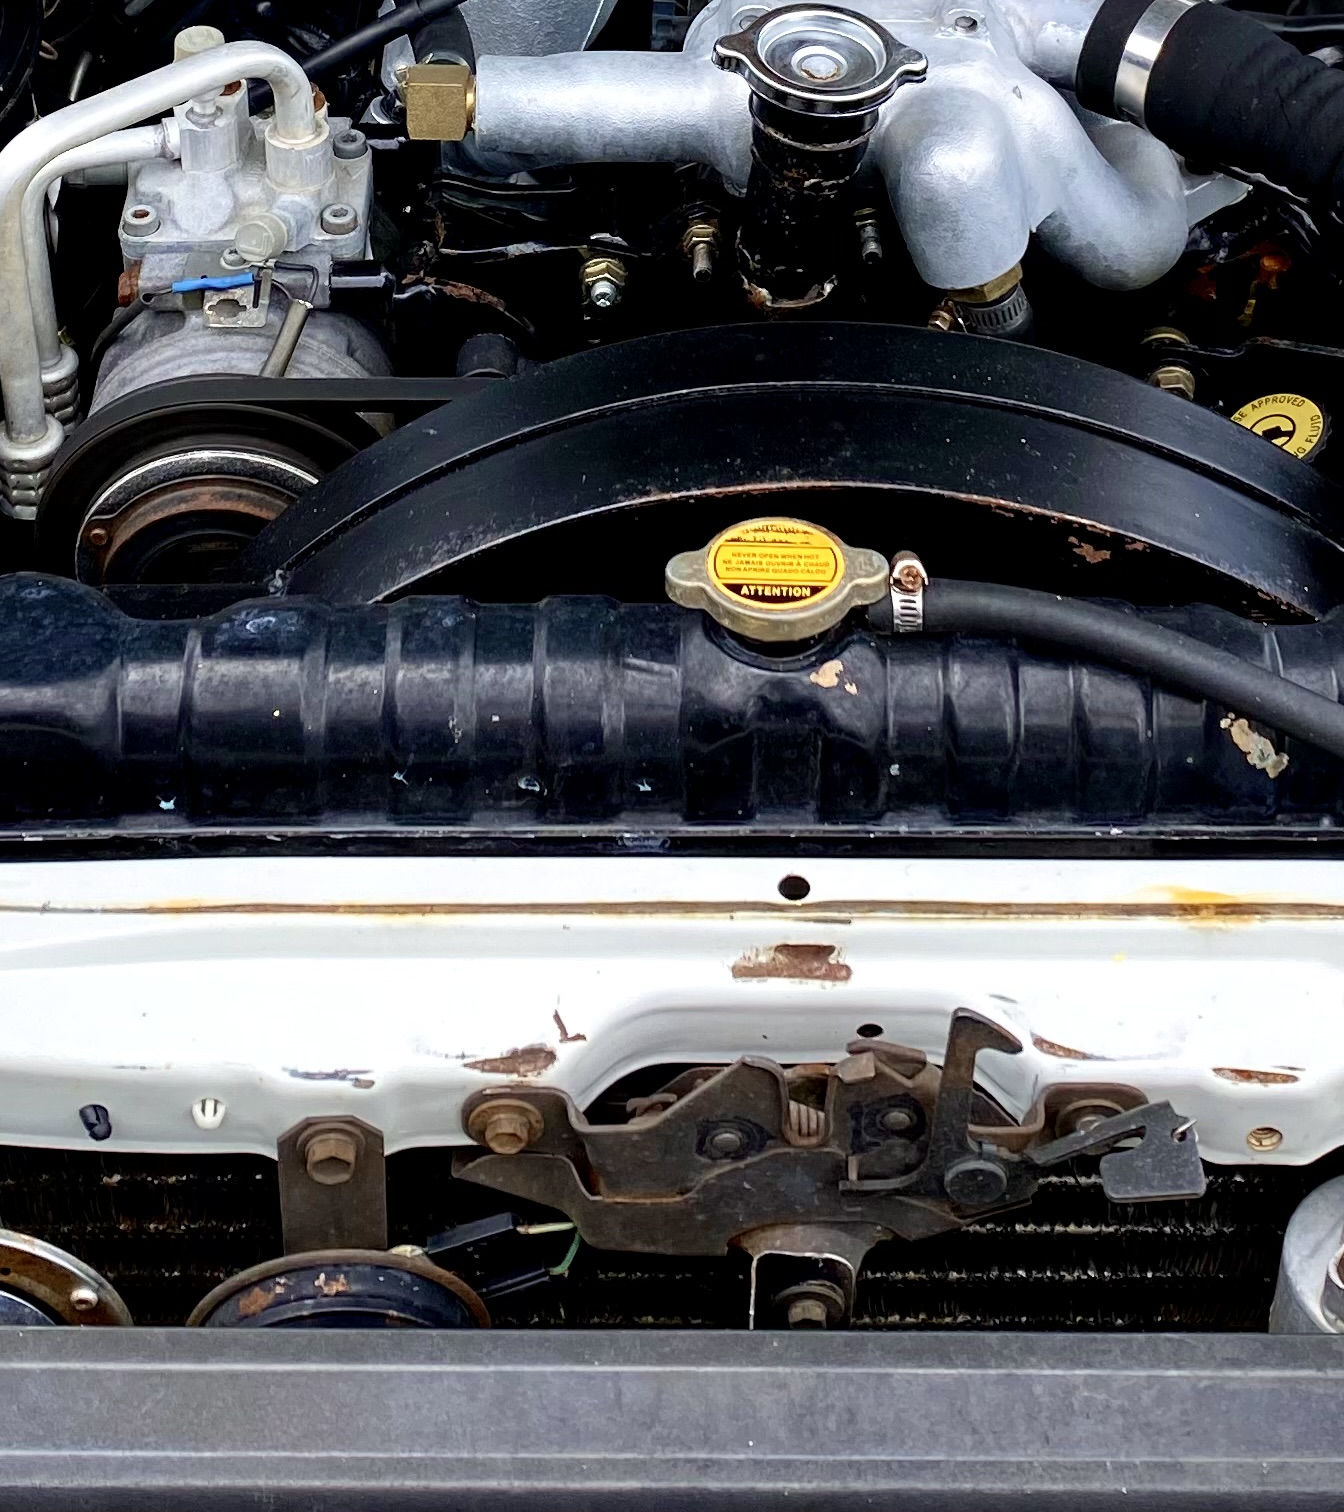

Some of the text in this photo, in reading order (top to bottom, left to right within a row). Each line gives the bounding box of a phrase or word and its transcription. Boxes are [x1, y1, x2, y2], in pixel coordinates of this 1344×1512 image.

[1250, 395, 1306, 411] APPROVED
[1304, 414, 1321, 444] FLUID
[740, 584, 811, 597] ATTENTION
